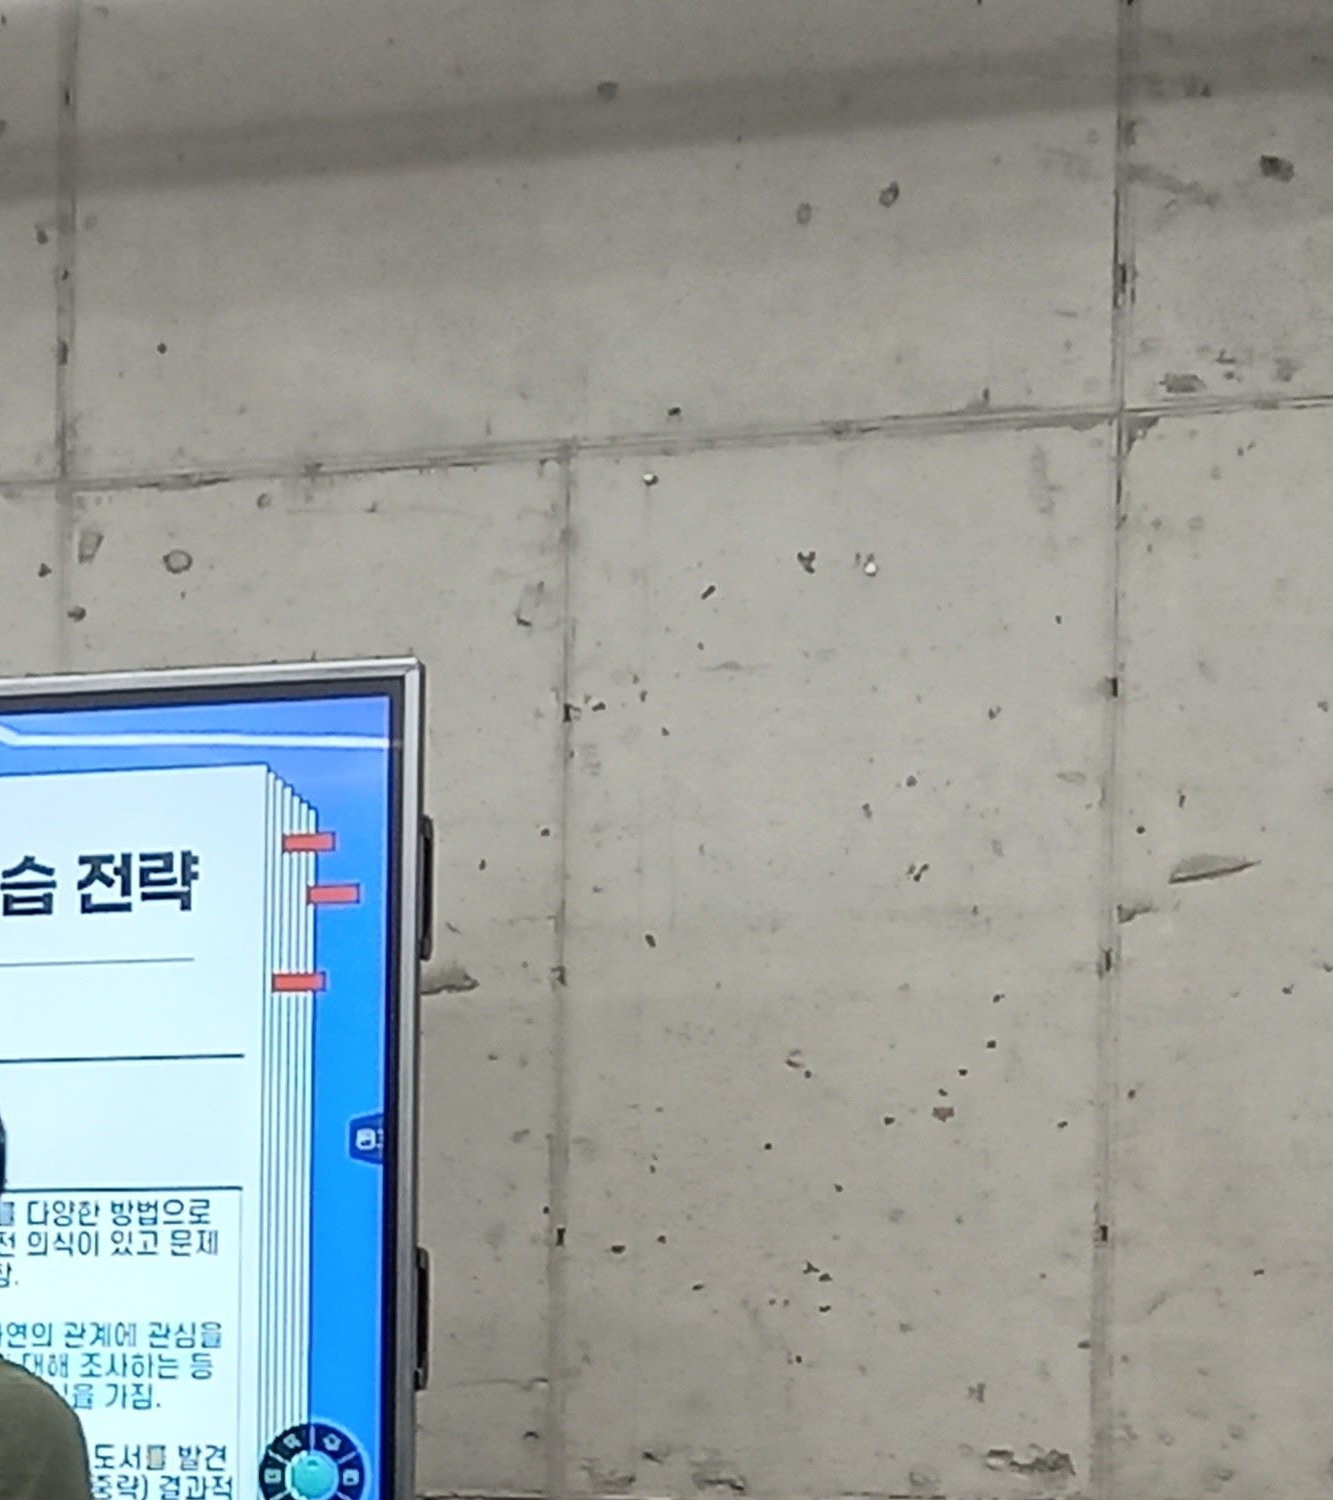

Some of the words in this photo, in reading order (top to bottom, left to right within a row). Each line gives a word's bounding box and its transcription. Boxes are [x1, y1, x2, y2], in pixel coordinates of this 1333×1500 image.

[77, 850, 199, 913] 전략
[27, 1200, 100, 1226] 다양한
[110, 1199, 212, 1226] 방법으로
[27, 1230, 100, 1257] 의식이
[110, 1229, 159, 1257] 있고
[170, 1229, 219, 1256] 문제
[64, 1321, 137, 1349] 관계에
[148, 1320, 222, 1349] 관심을
[80, 1352, 180, 1380] 조사하는
[189, 1352, 214, 1381] 등
[105, 1383, 162, 1411] 가짐.
[94, 1443, 166, 1471] 도서를
[178, 1443, 227, 1471] 발견
